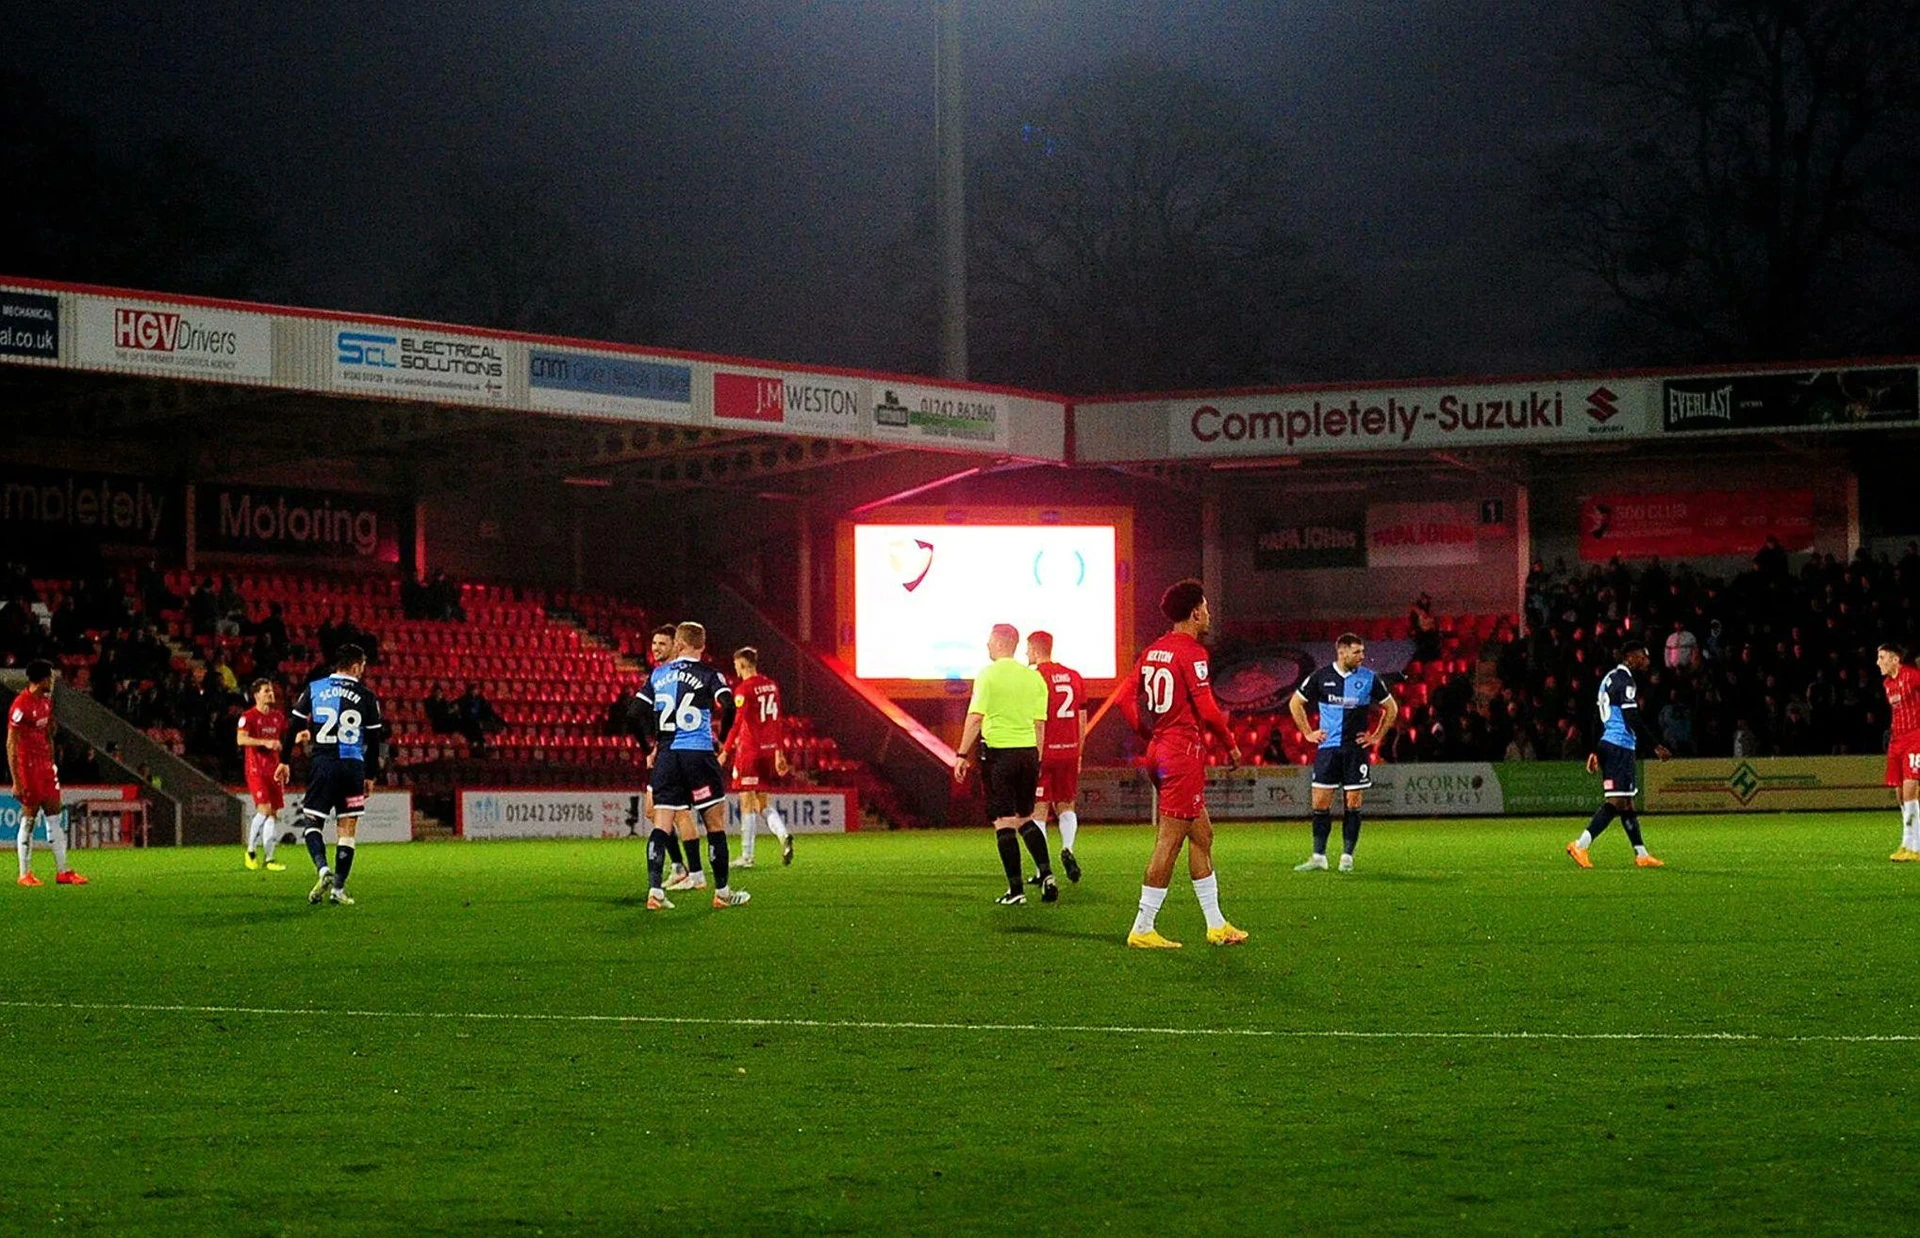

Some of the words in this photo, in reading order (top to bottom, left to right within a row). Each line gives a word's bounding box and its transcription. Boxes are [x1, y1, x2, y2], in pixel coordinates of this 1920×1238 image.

[116, 310, 178, 350] HGV
[179, 321, 236, 355] Drivers
[338, 332, 396, 368] SCL
[401, 338, 502, 360] ELECTRICAL
[401, 355, 502, 377] SOLUTIONS
[786, 385, 858, 415] WESTON
[1669, 384, 1734, 424] EVERLAST
[1191, 391, 1563, 445] Completely-Suzuki
[0, 476, 164, 542] mpletely
[220, 491, 377, 555] Motoring
[319, 686, 362, 705] SCOWEN
[654, 671, 704, 690] McCARTHY
[1141, 665, 1174, 714] 30
[654, 692, 702, 732] 26
[757, 693, 778, 723] 14
[1055, 684, 1075, 718] 2
[315, 706, 362, 744] 28
[1359, 764, 1368, 779] 9
[1406, 774, 1469, 792] ACORN
[506, 804, 545, 822] 01242
[548, 804, 594, 822] 239786
[1404, 792, 1483, 806] ENERGY
